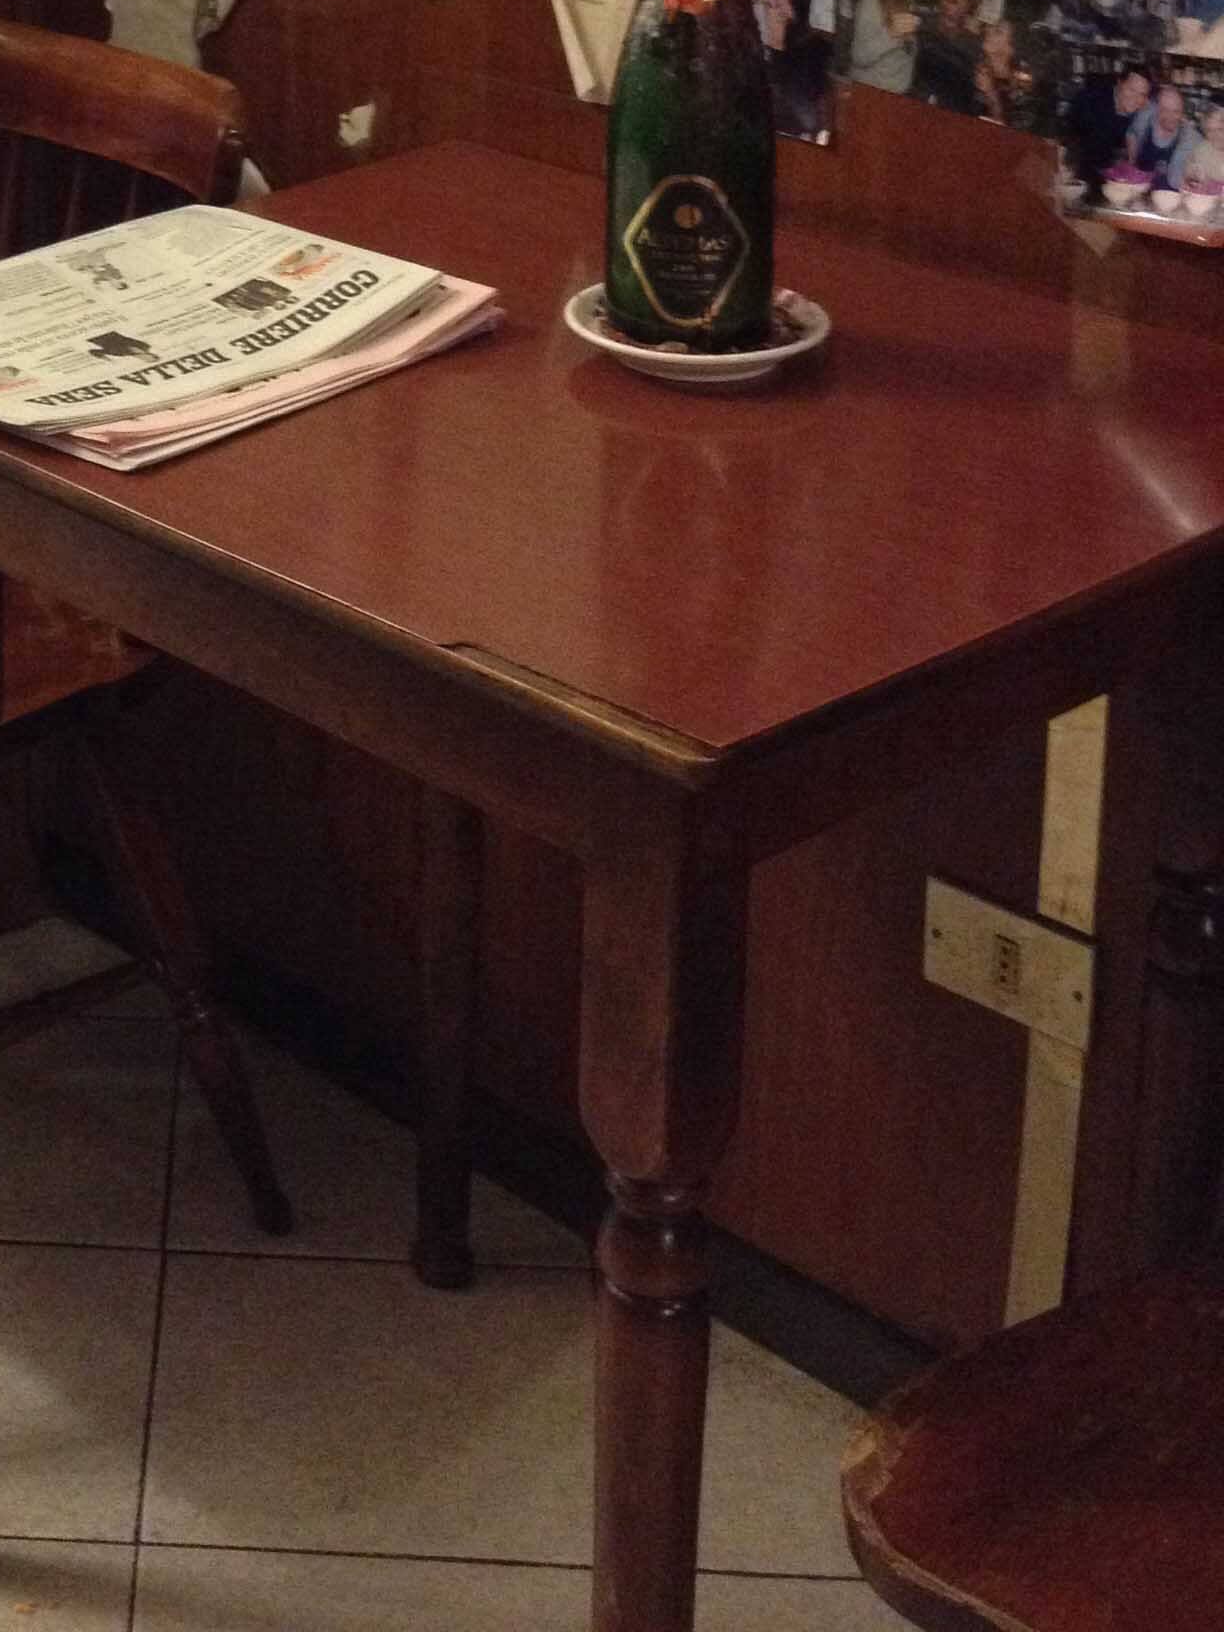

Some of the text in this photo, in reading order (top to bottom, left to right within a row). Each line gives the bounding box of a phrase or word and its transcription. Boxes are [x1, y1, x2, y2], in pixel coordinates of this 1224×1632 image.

[229, 269, 380, 355] CORRIERE
[120, 348, 232, 386] DELLA
[25, 380, 123, 406] SERA
